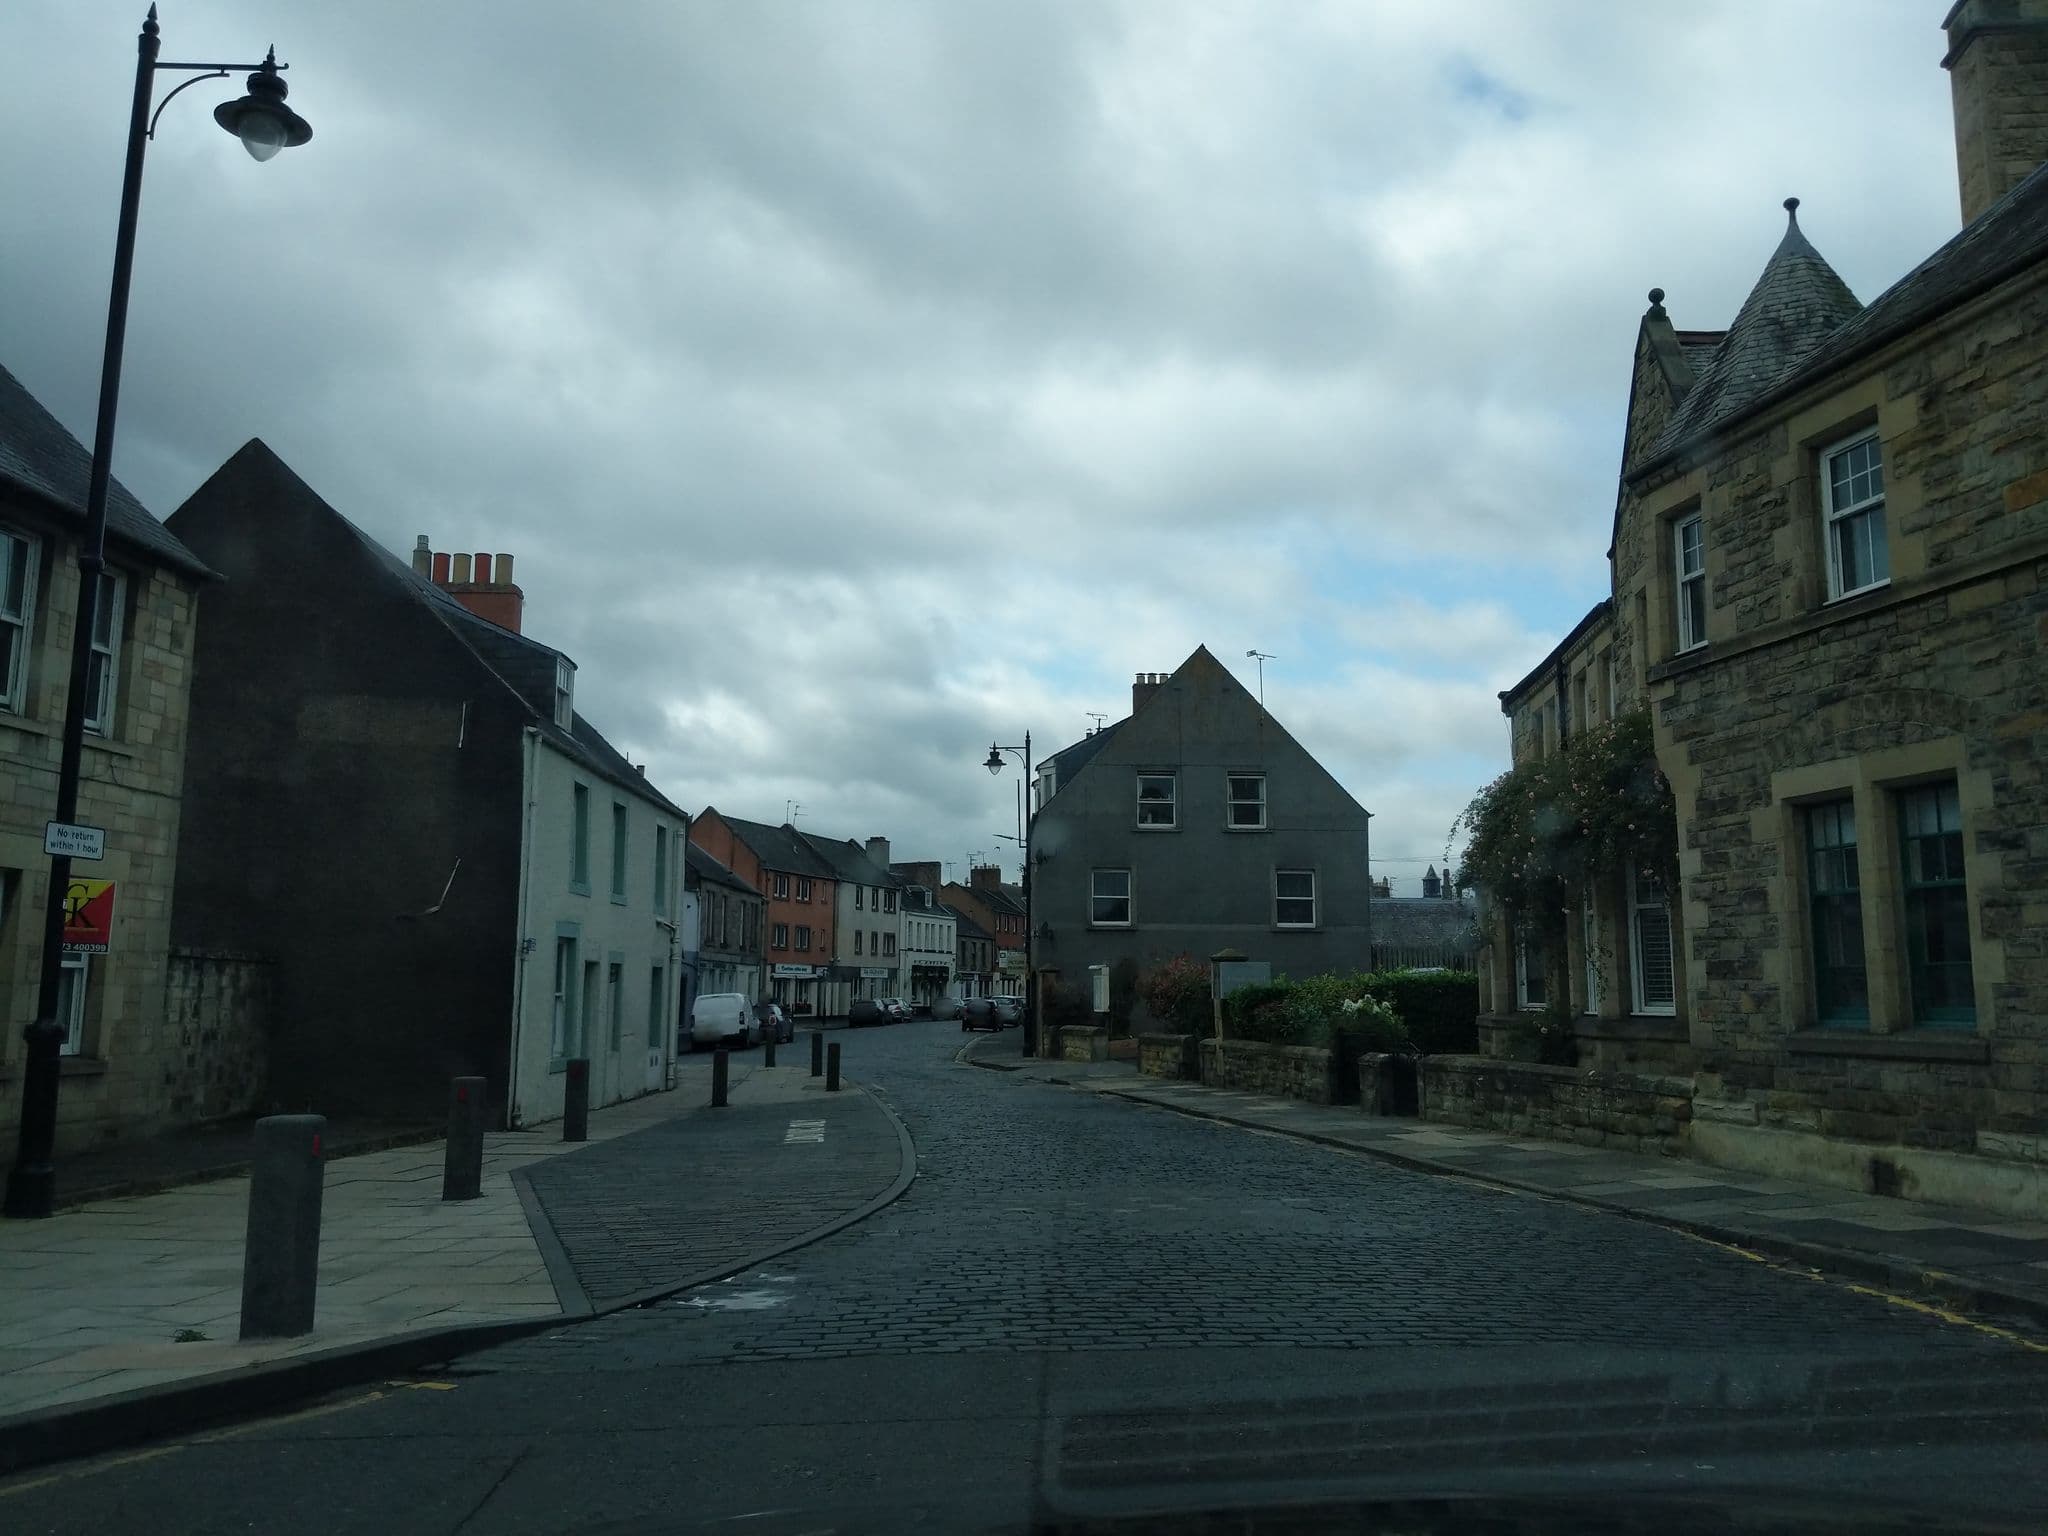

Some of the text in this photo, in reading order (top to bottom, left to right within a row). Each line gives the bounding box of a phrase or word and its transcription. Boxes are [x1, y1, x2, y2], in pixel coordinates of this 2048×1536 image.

[57, 828, 94, 841] No return
[50, 840, 74, 850] within
[82, 844, 99, 854] hour
[72, 943, 106, 951] 400399
